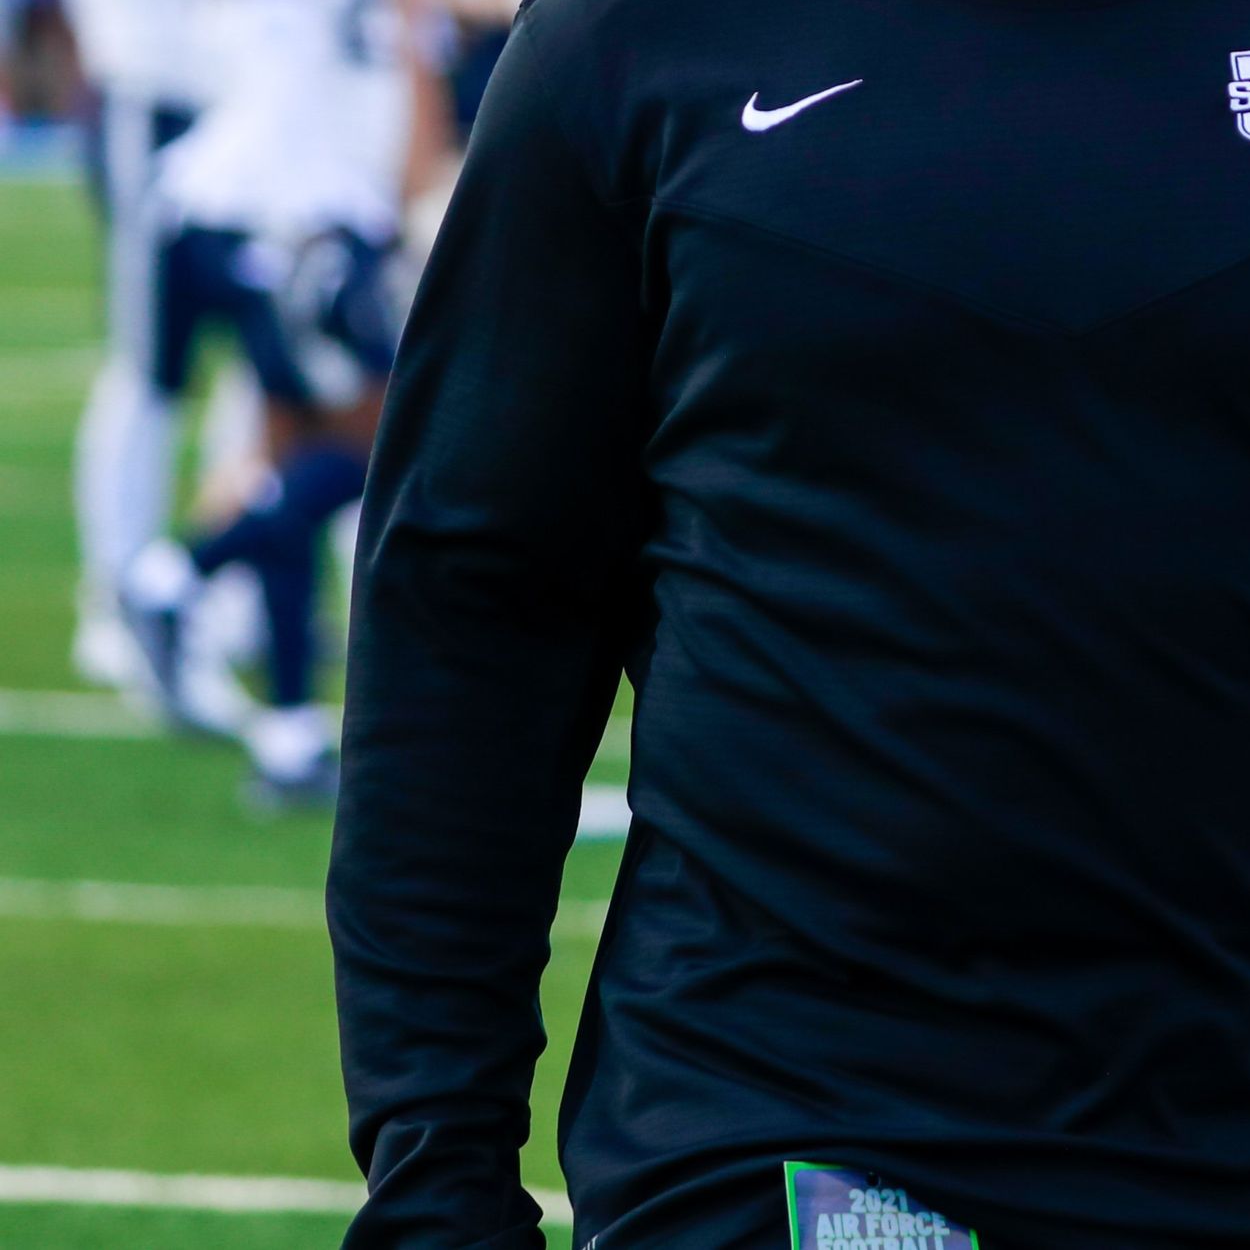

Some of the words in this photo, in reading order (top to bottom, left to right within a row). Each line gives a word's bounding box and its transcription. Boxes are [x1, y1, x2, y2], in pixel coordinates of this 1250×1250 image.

[849, 1188, 908, 1213] 2021
[816, 1213, 861, 1238] AIR
[865, 1212, 950, 1237] FORCE
